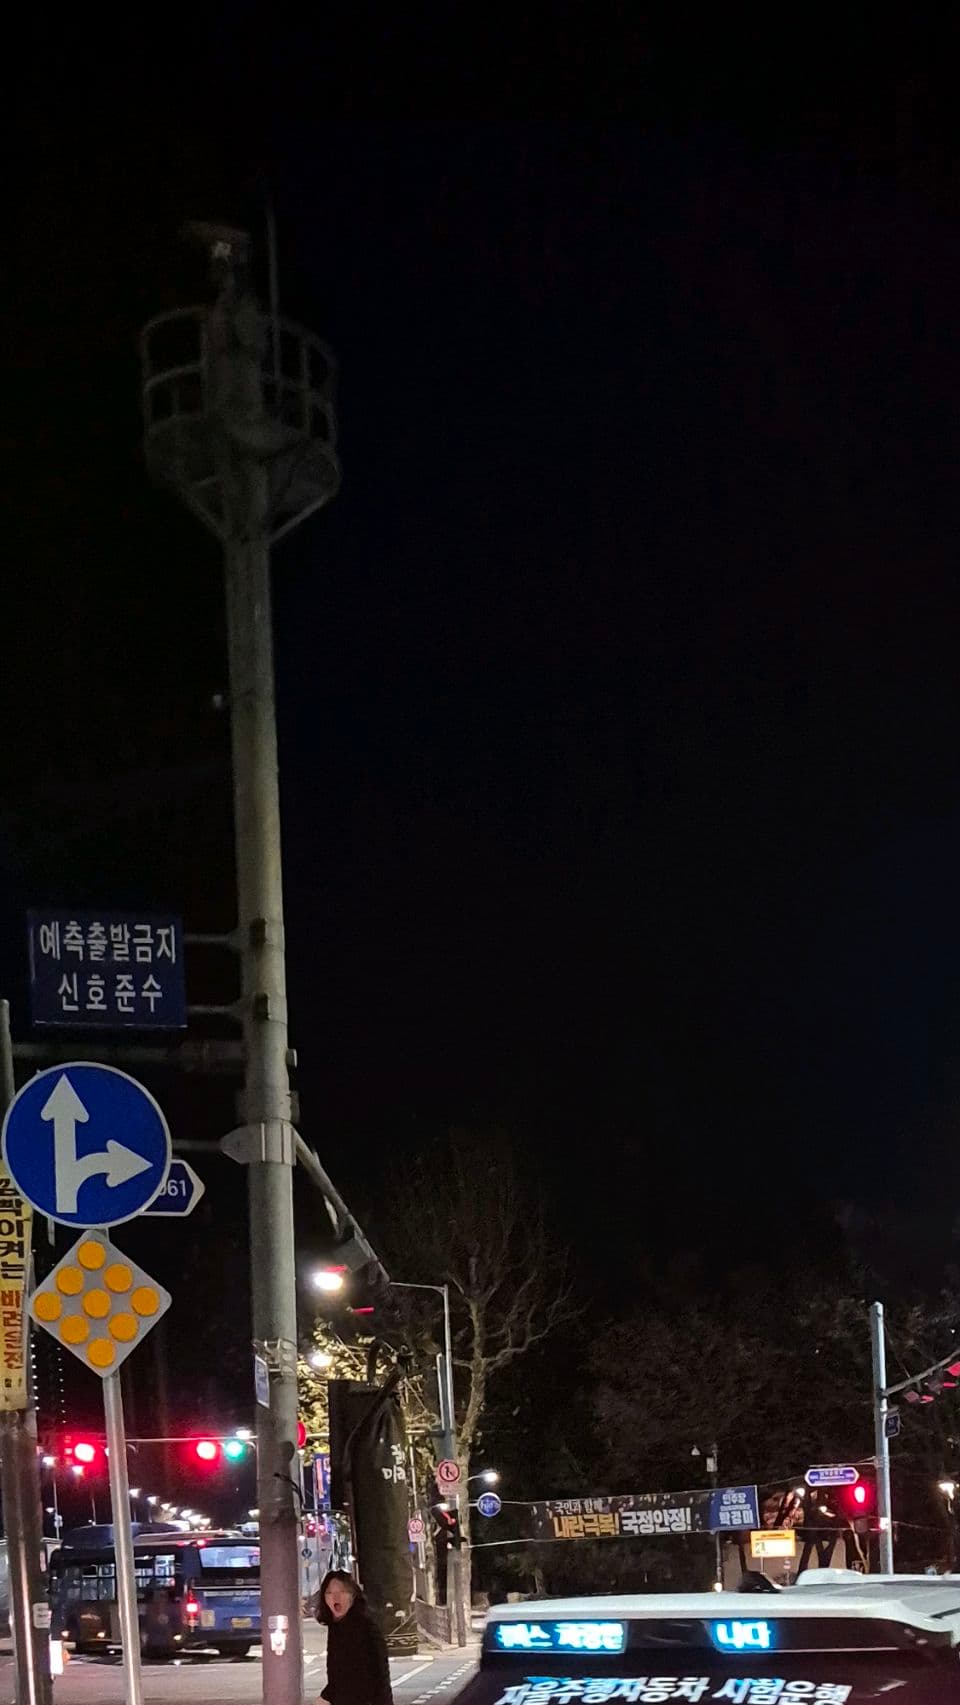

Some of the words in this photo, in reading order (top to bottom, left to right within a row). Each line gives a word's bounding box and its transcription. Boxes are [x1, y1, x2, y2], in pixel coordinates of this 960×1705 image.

[39, 920, 176, 964] 예측출발금지
[57, 972, 163, 1013] 신호준수
[552, 1512, 620, 1538] 내란극복!
[621, 1506, 692, 1535] 국정안정!
